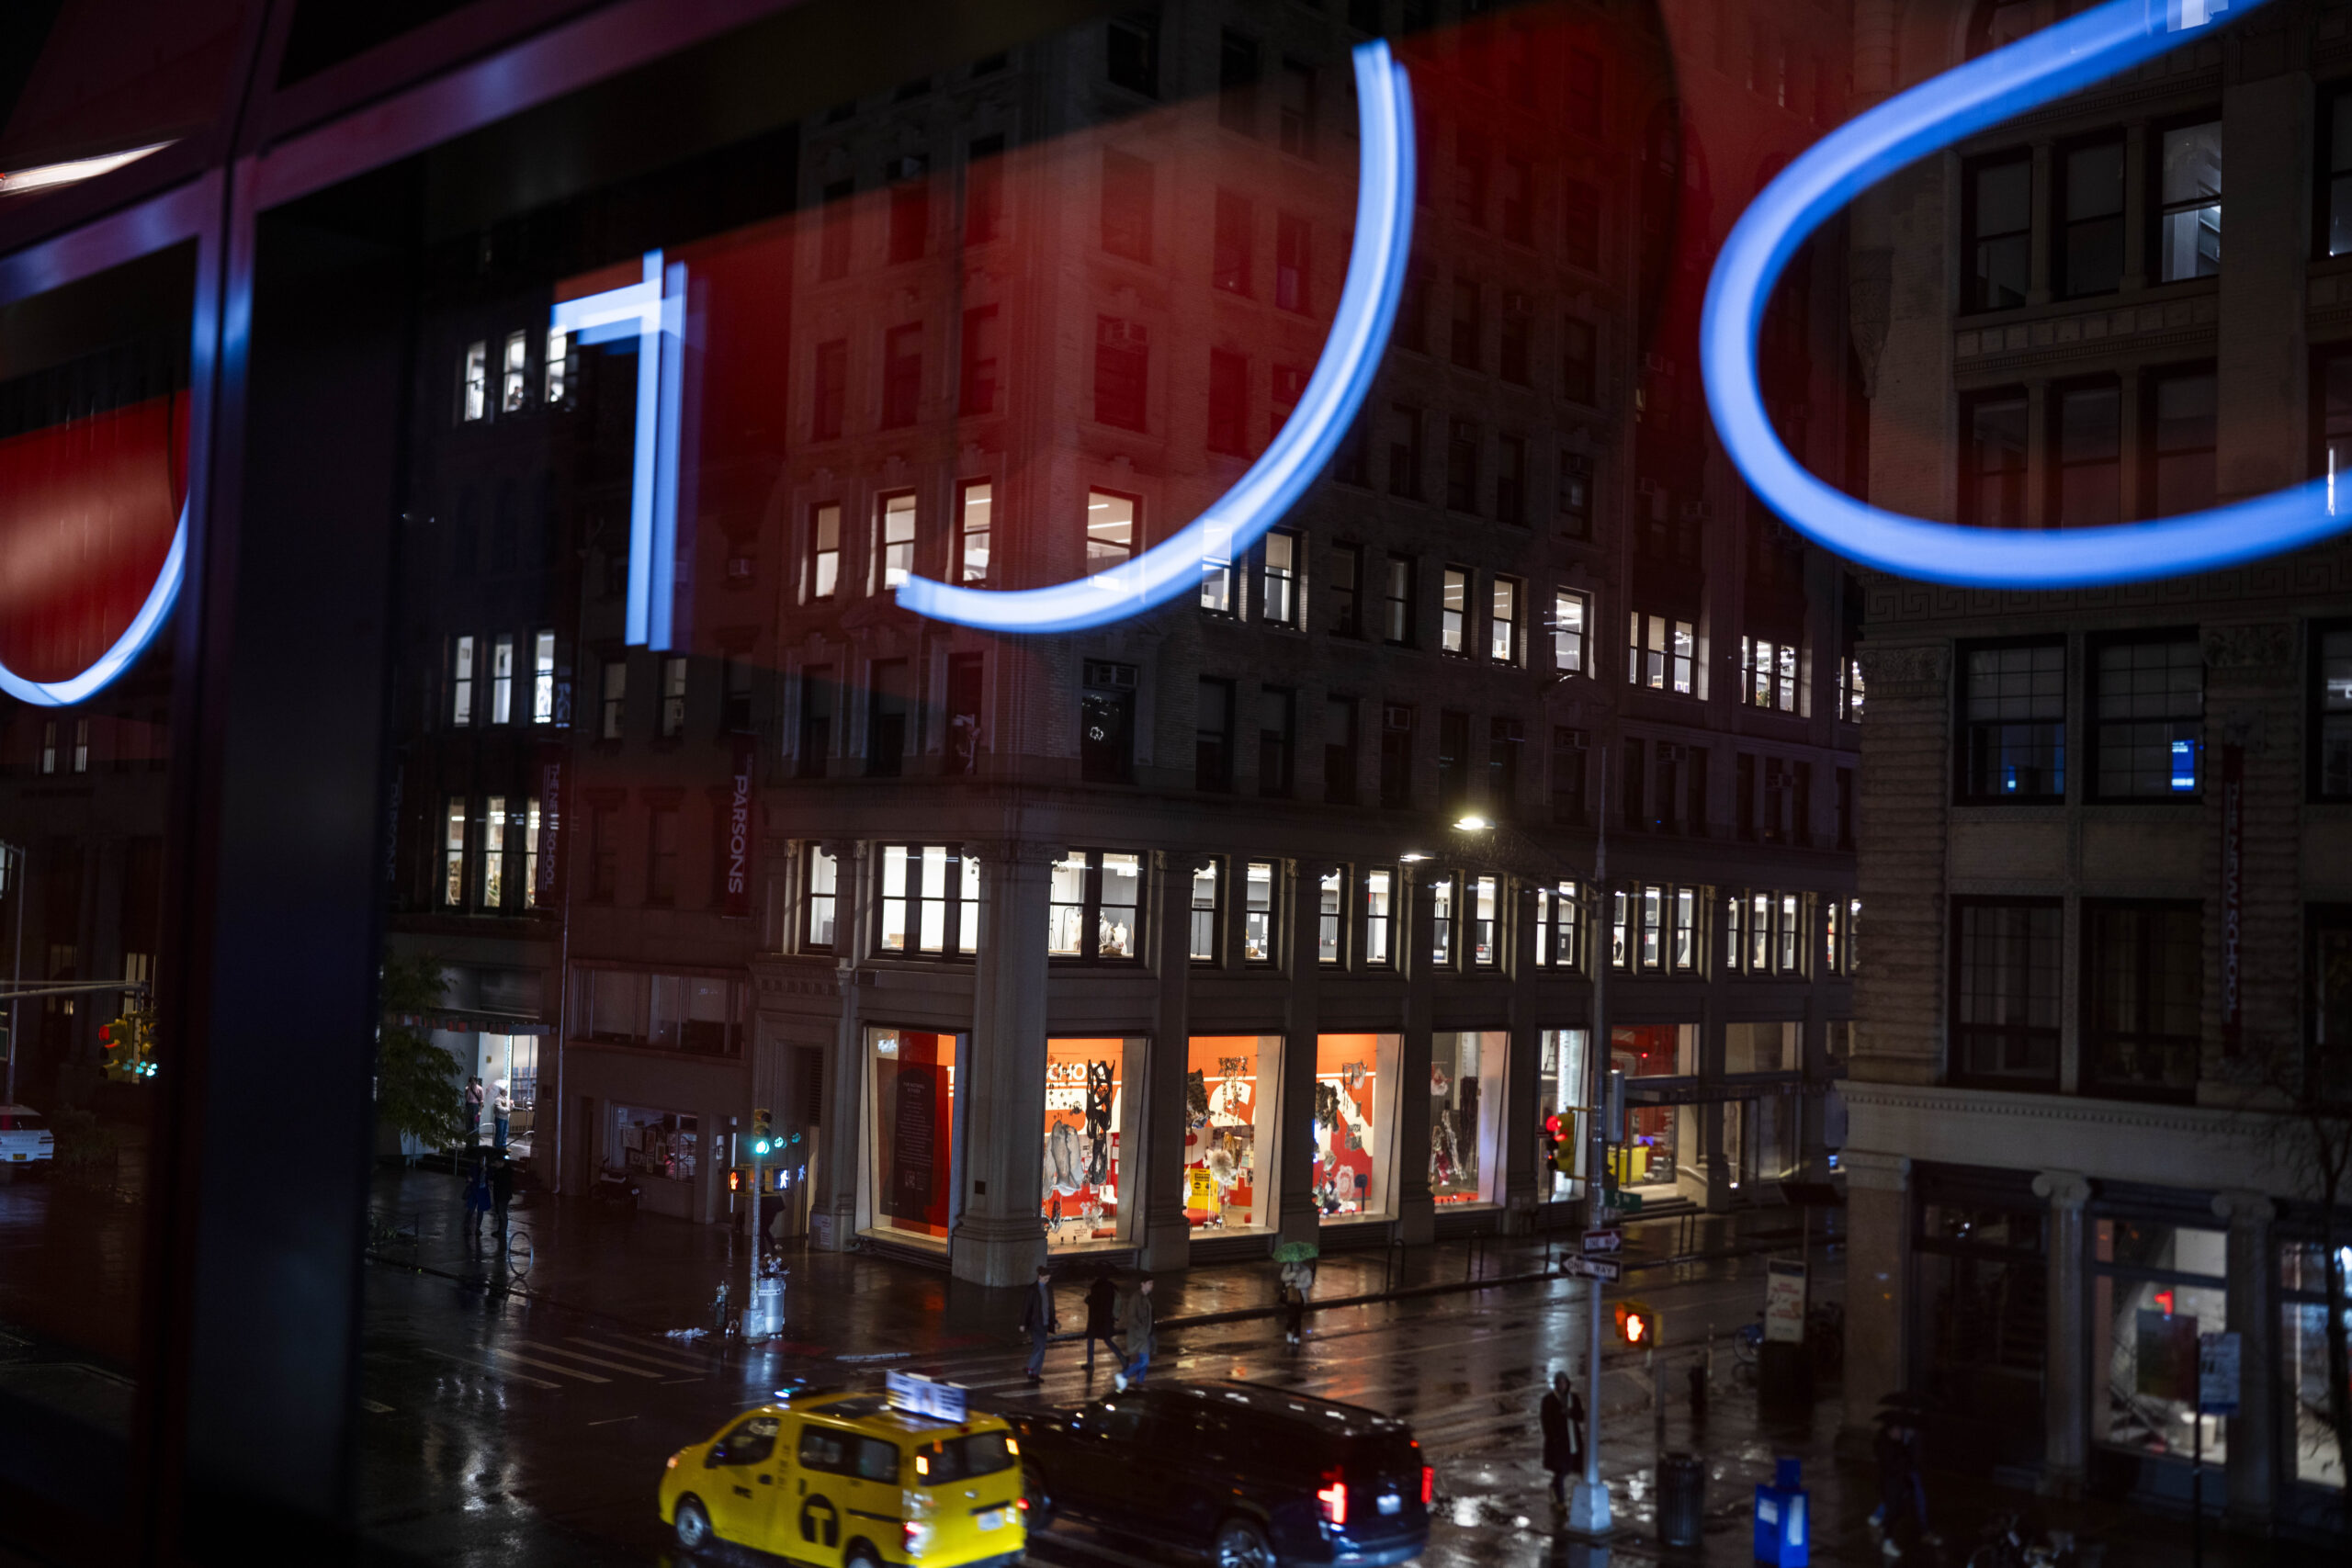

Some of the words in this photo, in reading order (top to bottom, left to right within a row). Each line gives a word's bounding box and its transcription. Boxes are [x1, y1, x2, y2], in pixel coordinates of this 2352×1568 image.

[545, 830, 558, 890] SCHOOL
[728, 773, 750, 895] PARSONS
[2227, 835, 2240, 906] NEW
[2226, 908, 2239, 1025] SCHOOL
[1593, 1262, 1612, 1275] WAY
